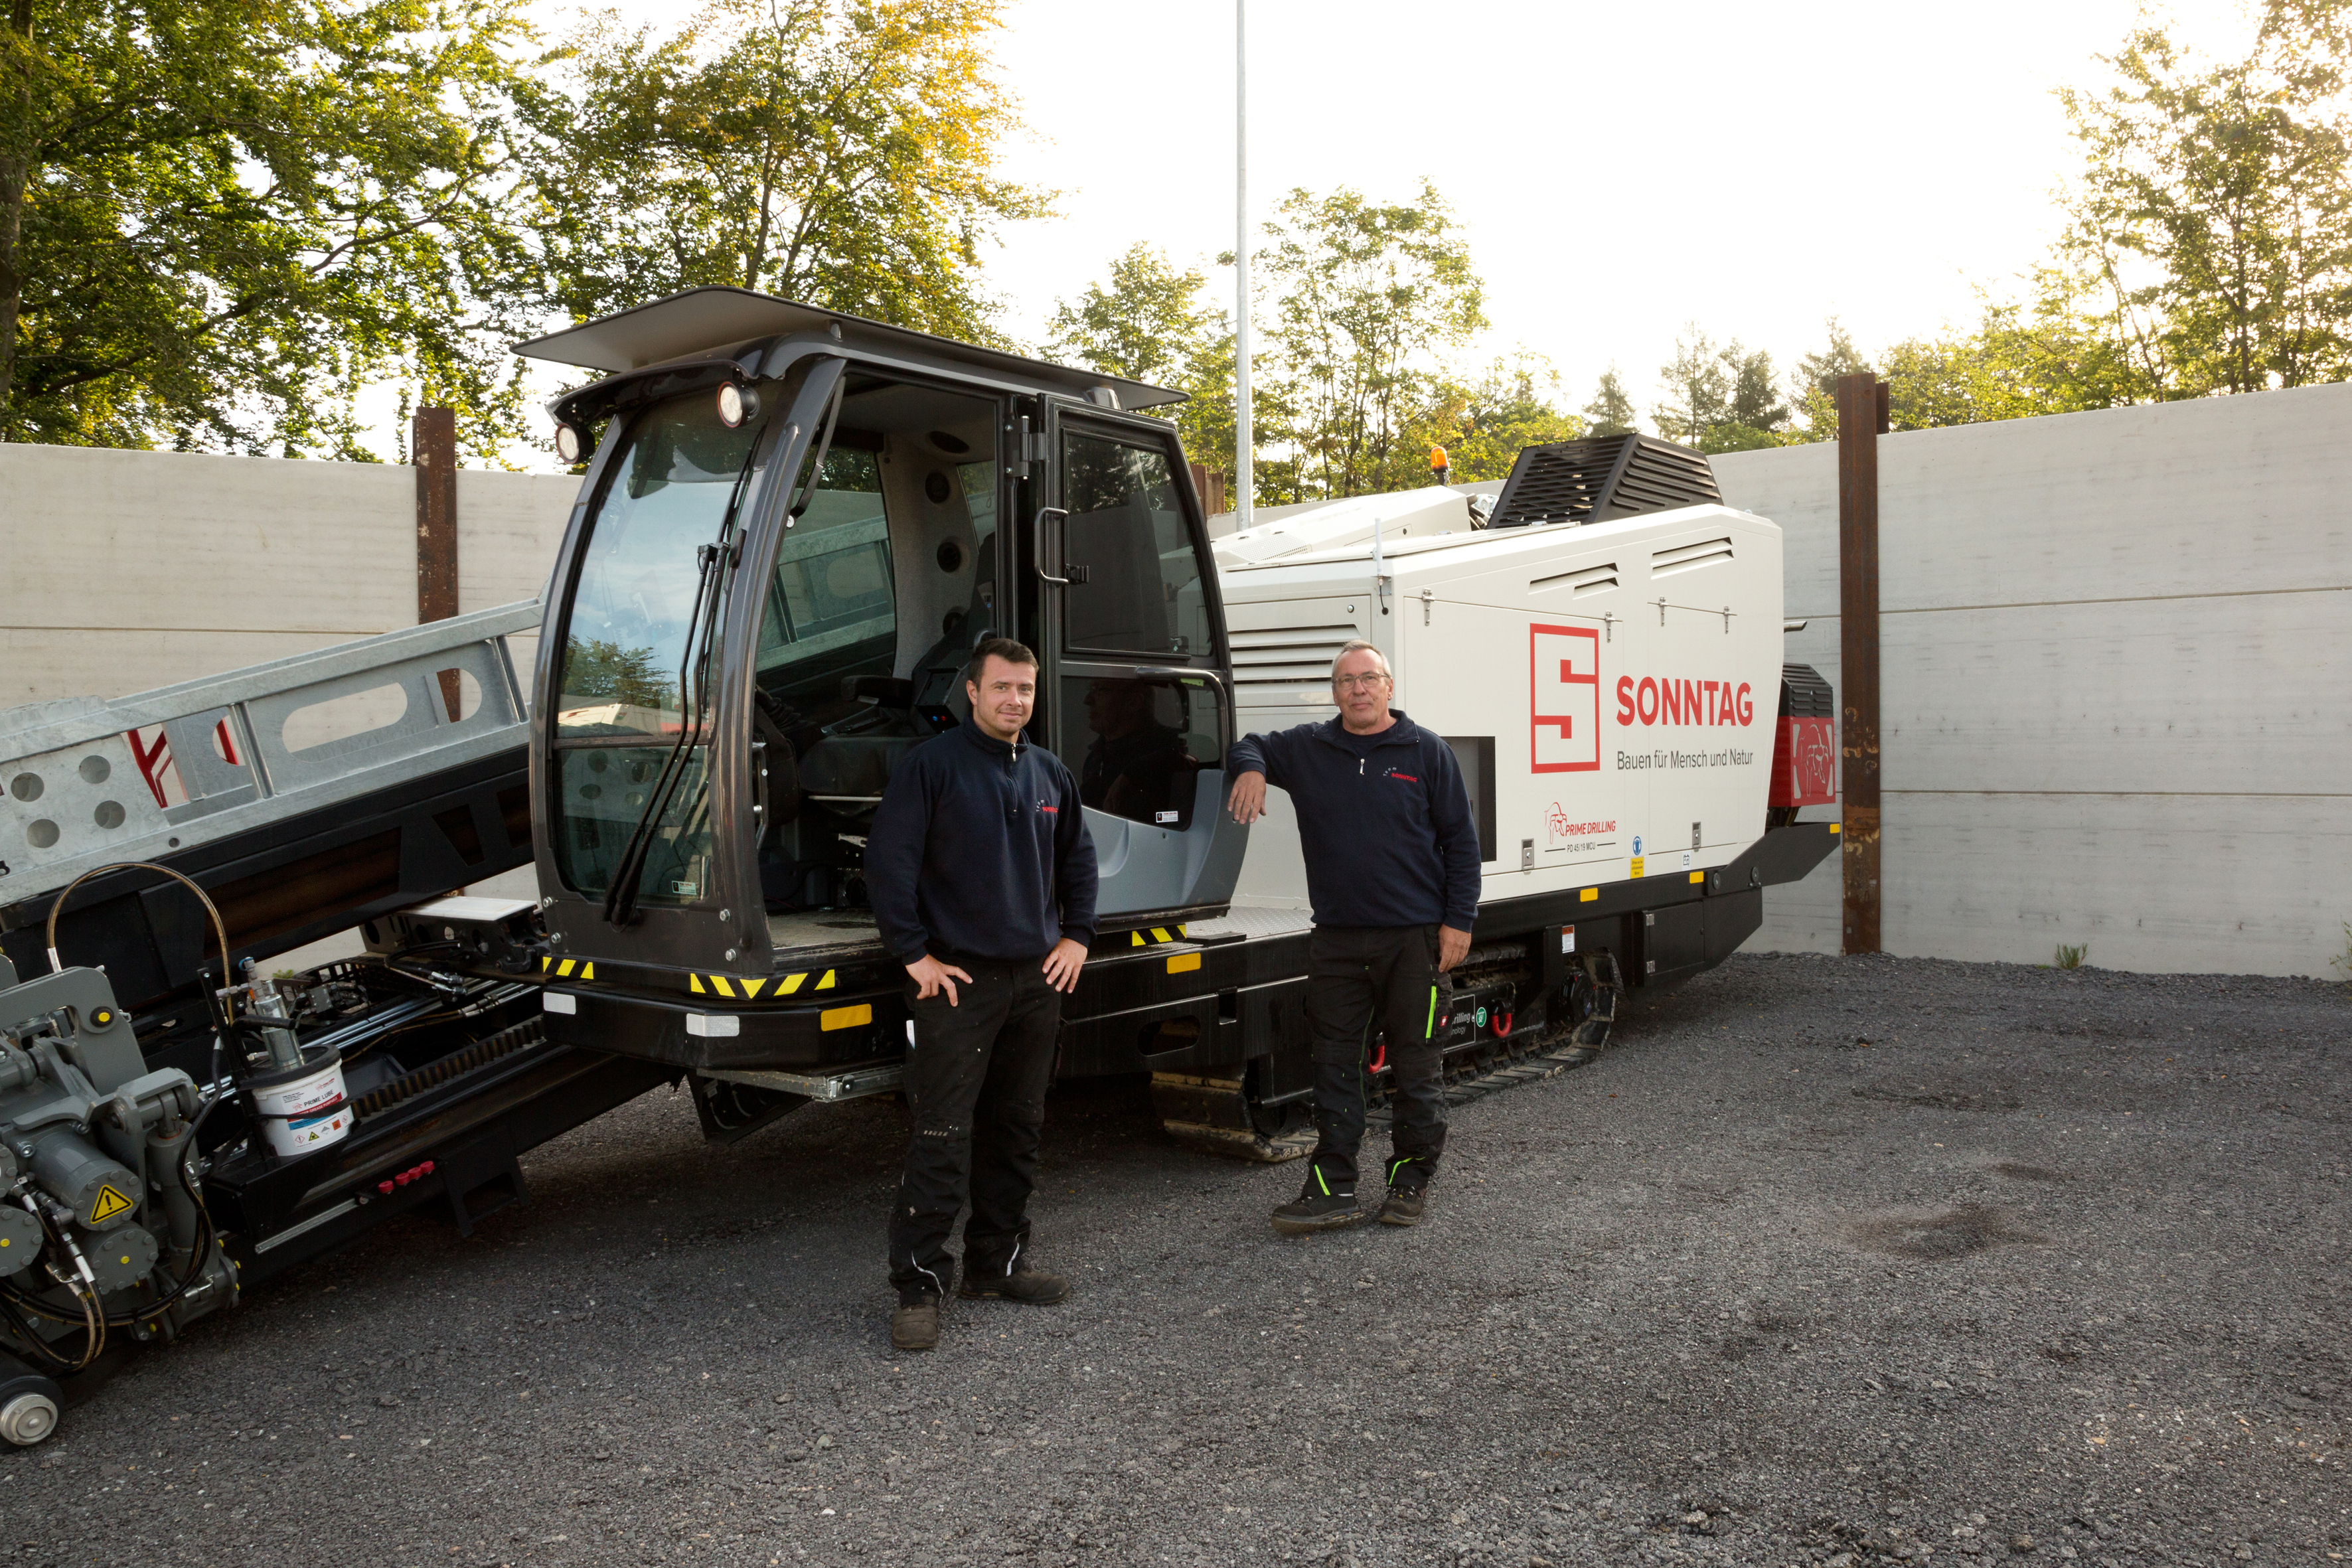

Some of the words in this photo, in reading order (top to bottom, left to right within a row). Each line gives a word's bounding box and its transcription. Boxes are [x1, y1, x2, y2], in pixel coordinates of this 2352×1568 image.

[1616, 676, 1753, 726] SONNTAG
[1618, 751, 1651, 770] Bauen
[1654, 749, 1668, 769] für
[1670, 750, 1707, 769] Mensch
[1710, 749, 1727, 767] und
[1729, 749, 1753, 765] Natur
[1391, 772, 1417, 782] SONNTAG
[1565, 823, 1587, 836] PRIME
[1587, 820, 1616, 834] DRILLING
[1567, 844, 1573, 853] PD
[1586, 842, 1596, 850] MCU
[1452, 1012, 1470, 1024] rilling
[1452, 1026, 1466, 1035] nology
[303, 1095, 321, 1107] PRIME
[322, 1089, 334, 1099] LUBE
